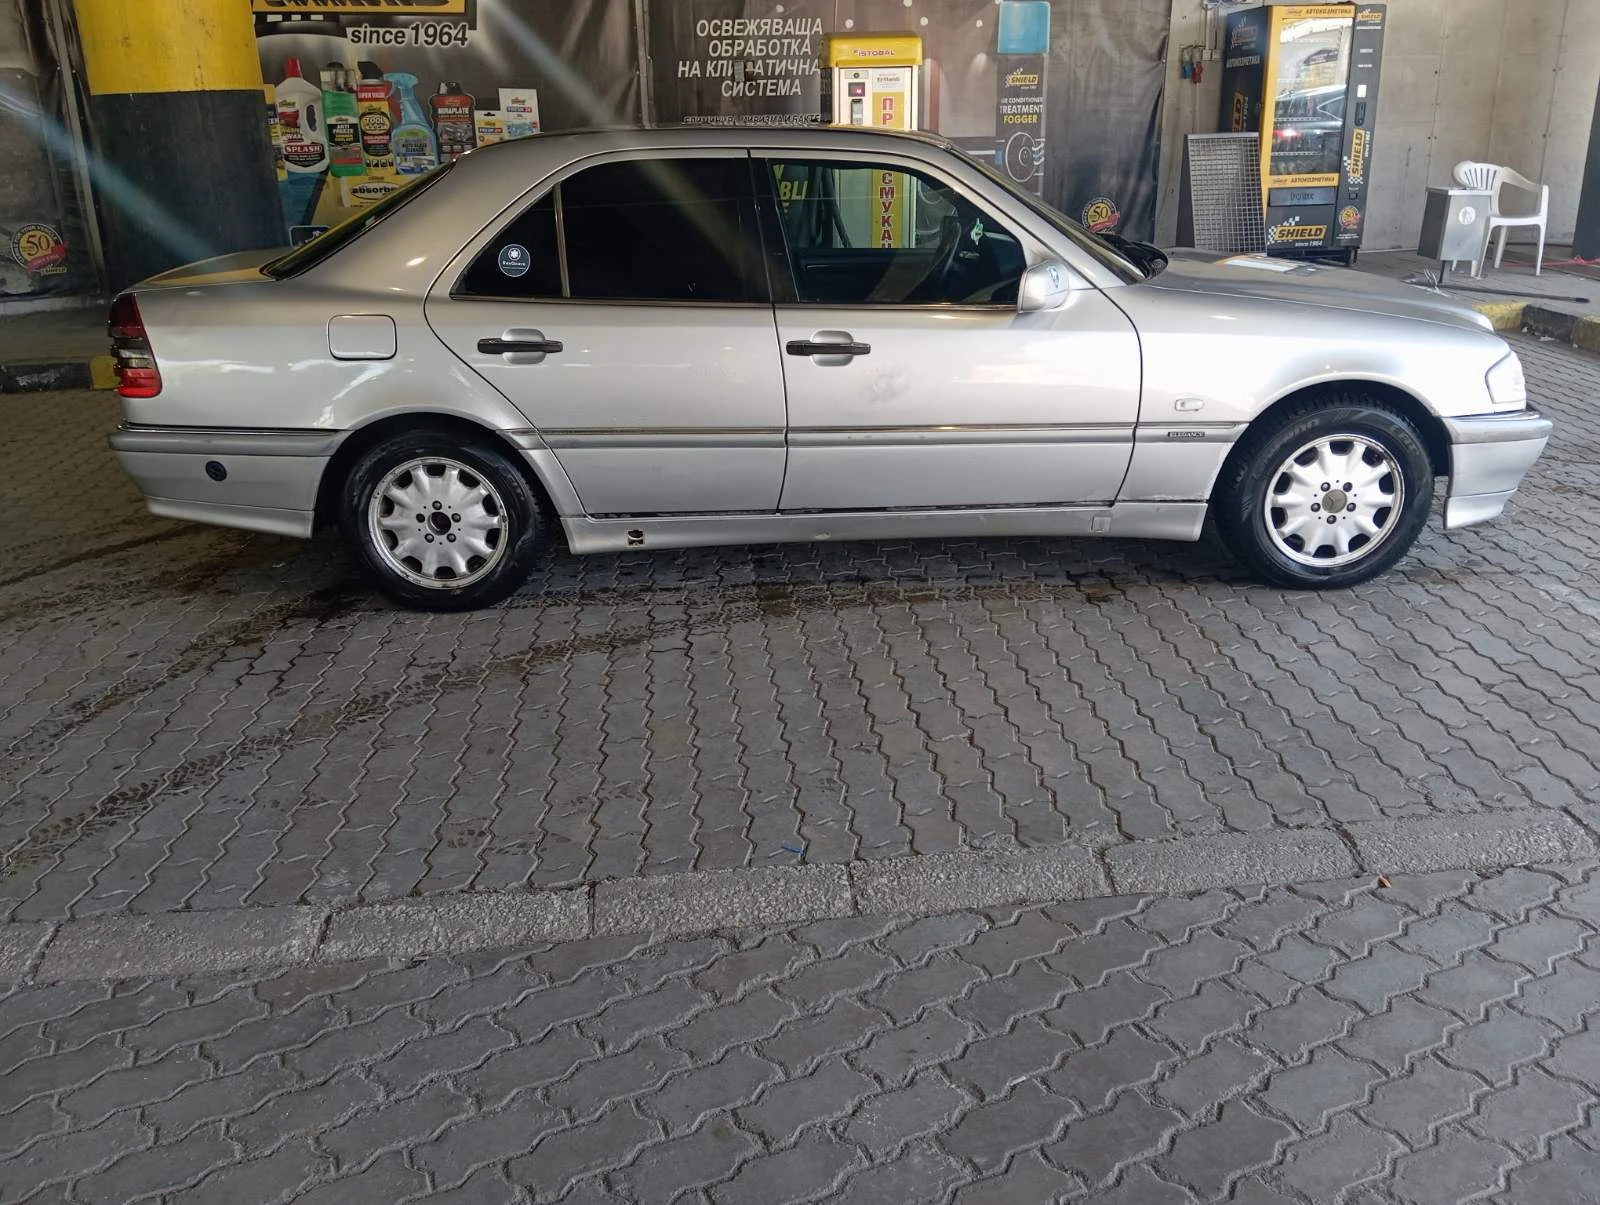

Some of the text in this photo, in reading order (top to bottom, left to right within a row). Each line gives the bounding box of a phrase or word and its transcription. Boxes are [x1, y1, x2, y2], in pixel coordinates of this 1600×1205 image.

[350, 24, 467, 46] since 1964
[696, 18, 823, 38] ОСВЕЖЯВАЩА
[708, 39, 812, 57] ОБРАБОТКА
[678, 59, 820, 78] НА КЛИАТИЧНА
[721, 79, 802, 96] СИСТЕМА
[1011, 76, 1037, 84] SHIELD
[1000, 104, 1043, 114] TREATMENT
[1003, 115, 1038, 124] FOGGER
[286, 145, 321, 154] SPLASH
[1352, 132, 1363, 174] SHIELD
[1093, 206, 1109, 222] 50
[1277, 228, 1324, 238] SHIELD
[27, 235, 50, 256] 50
